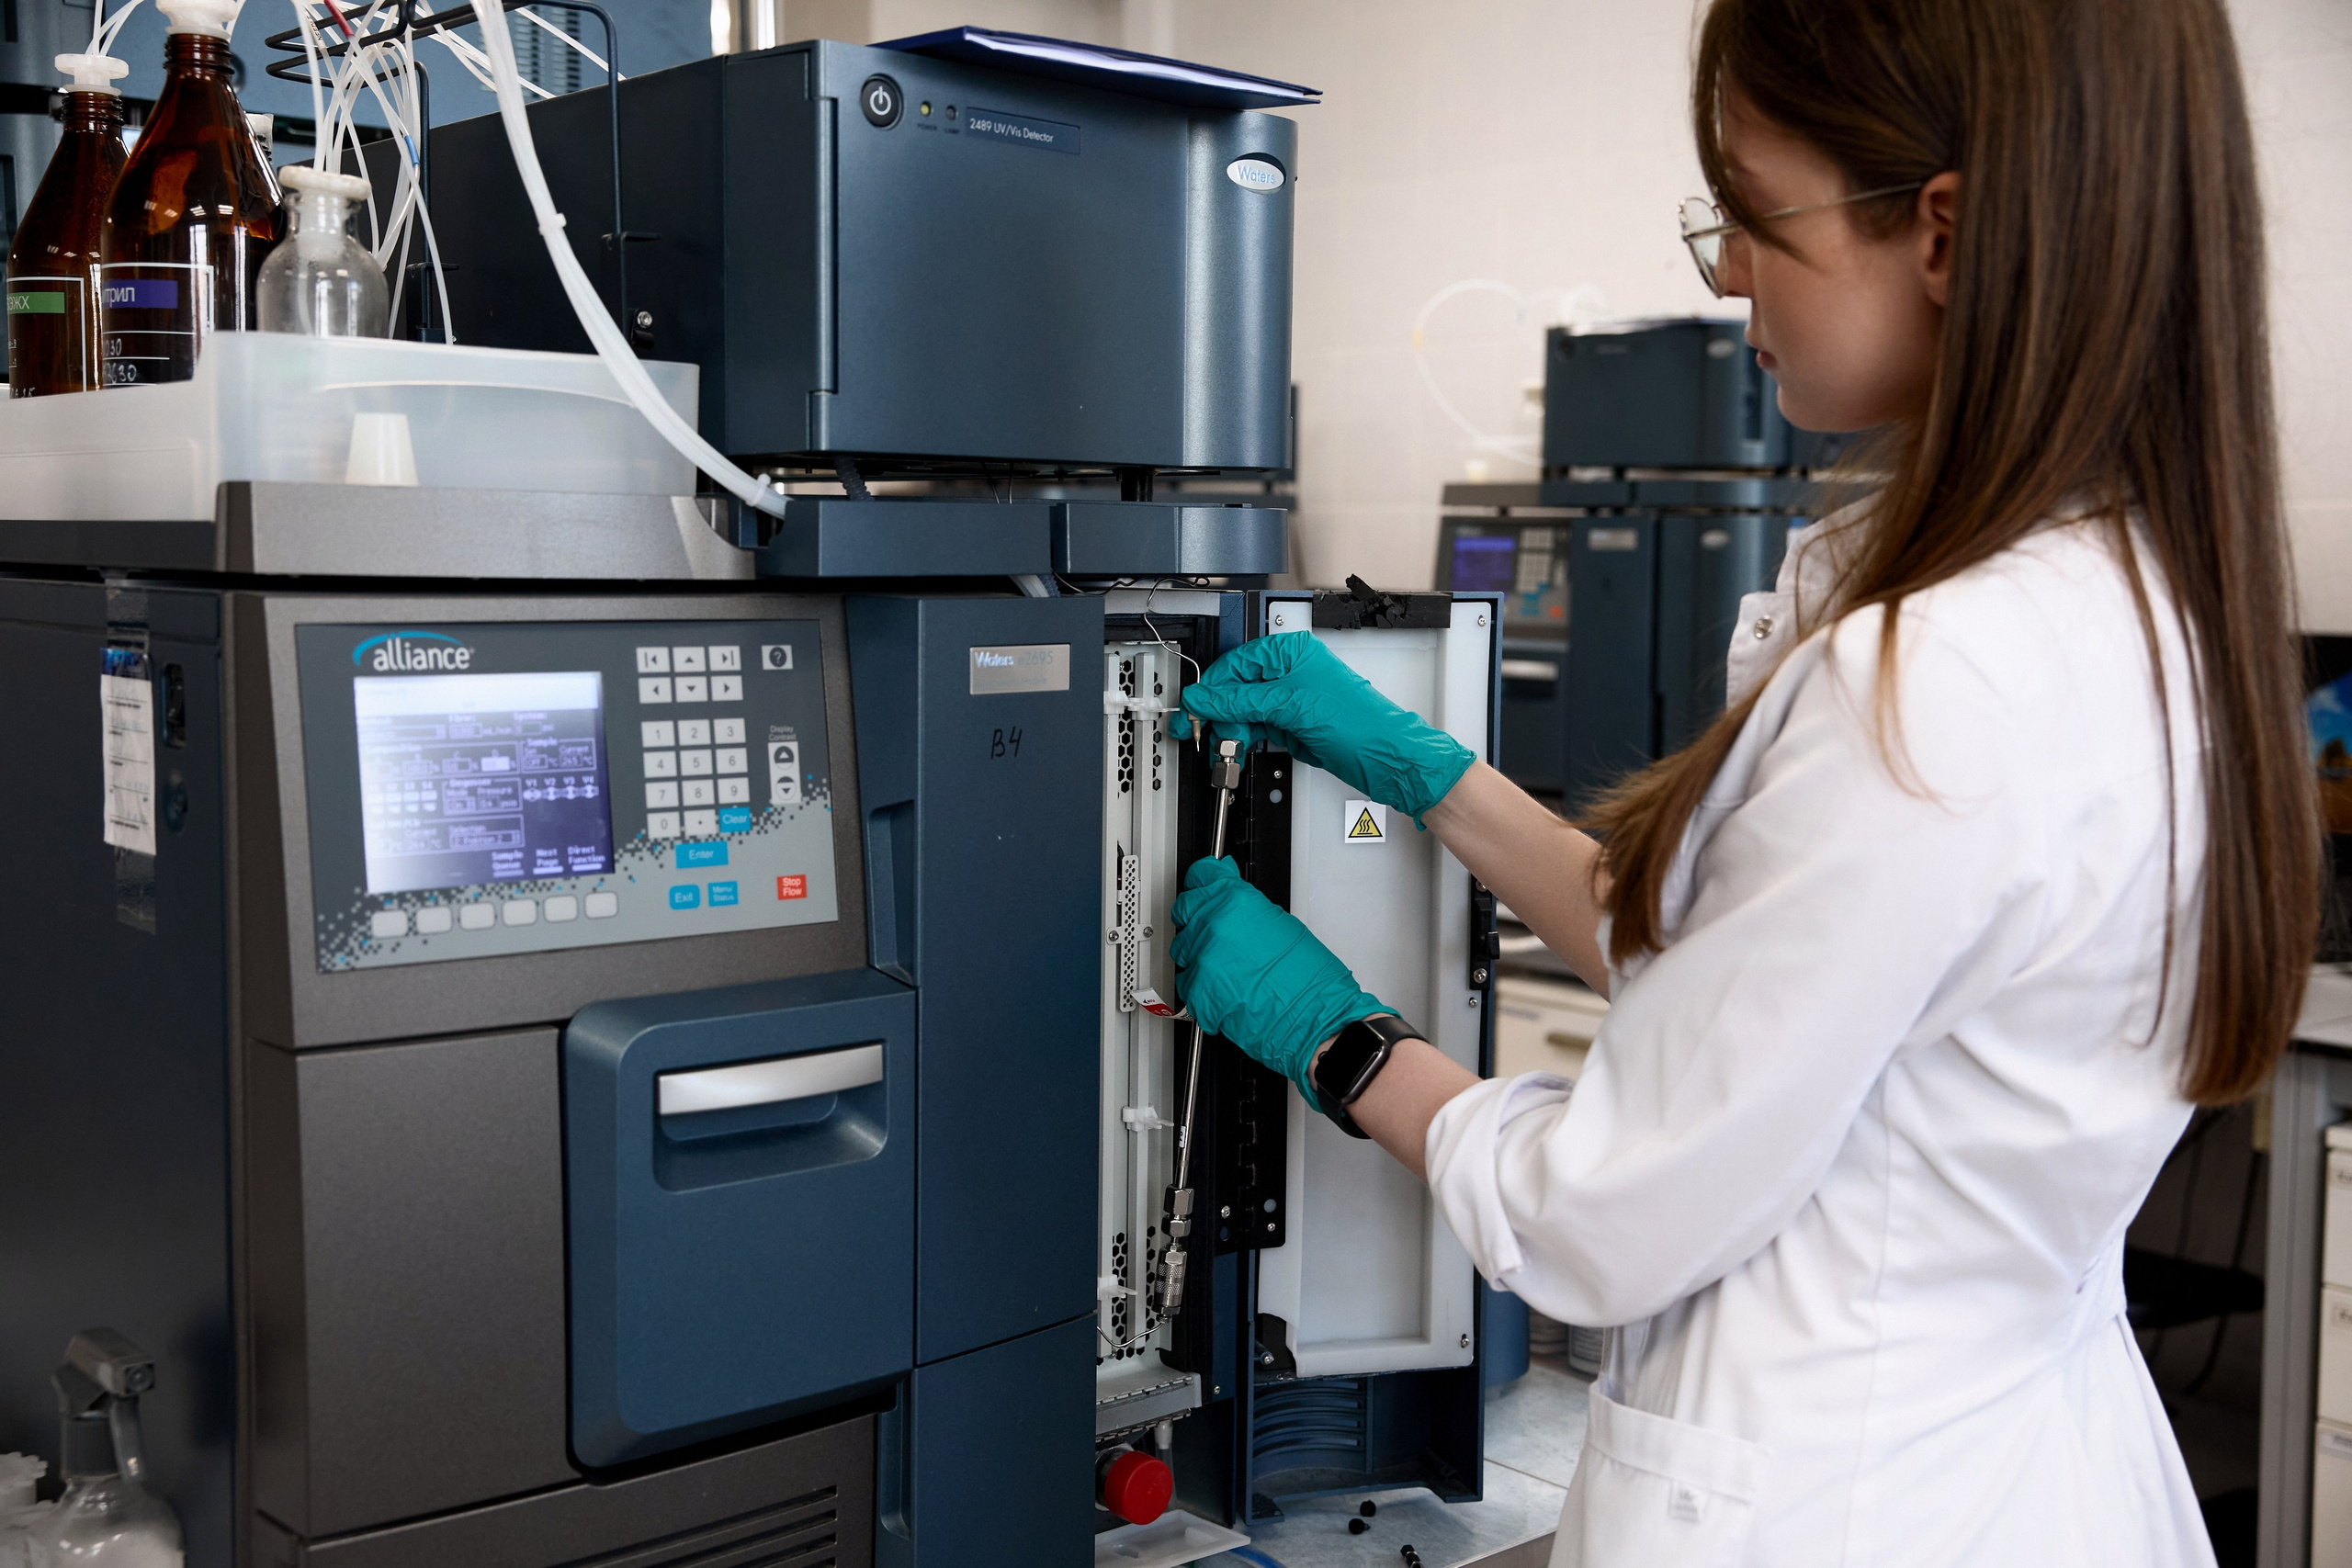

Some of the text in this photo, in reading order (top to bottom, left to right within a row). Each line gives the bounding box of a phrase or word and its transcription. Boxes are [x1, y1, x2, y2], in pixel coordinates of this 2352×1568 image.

[969, 118, 1054, 143] 2489 UV/Vis Detector
[1237, 164, 1276, 185] Waters
[372, 636, 471, 671] alliance
[974, 649, 1054, 668] Waters e2695
[655, 726, 734, 740] 1 2 3
[770, 726, 794, 734] Display
[768, 733, 797, 741] Contrast
[657, 755, 736, 770] 4 5 6
[659, 785, 738, 801] 7 8 9
[661, 818, 668, 829] 0
[722, 813, 748, 824] Clear
[567, 844, 595, 855] Direct
[689, 849, 714, 860] Enter
[783, 877, 801, 887] Stop
[783, 886, 802, 897] Flow
[674, 893, 694, 903] Exit
